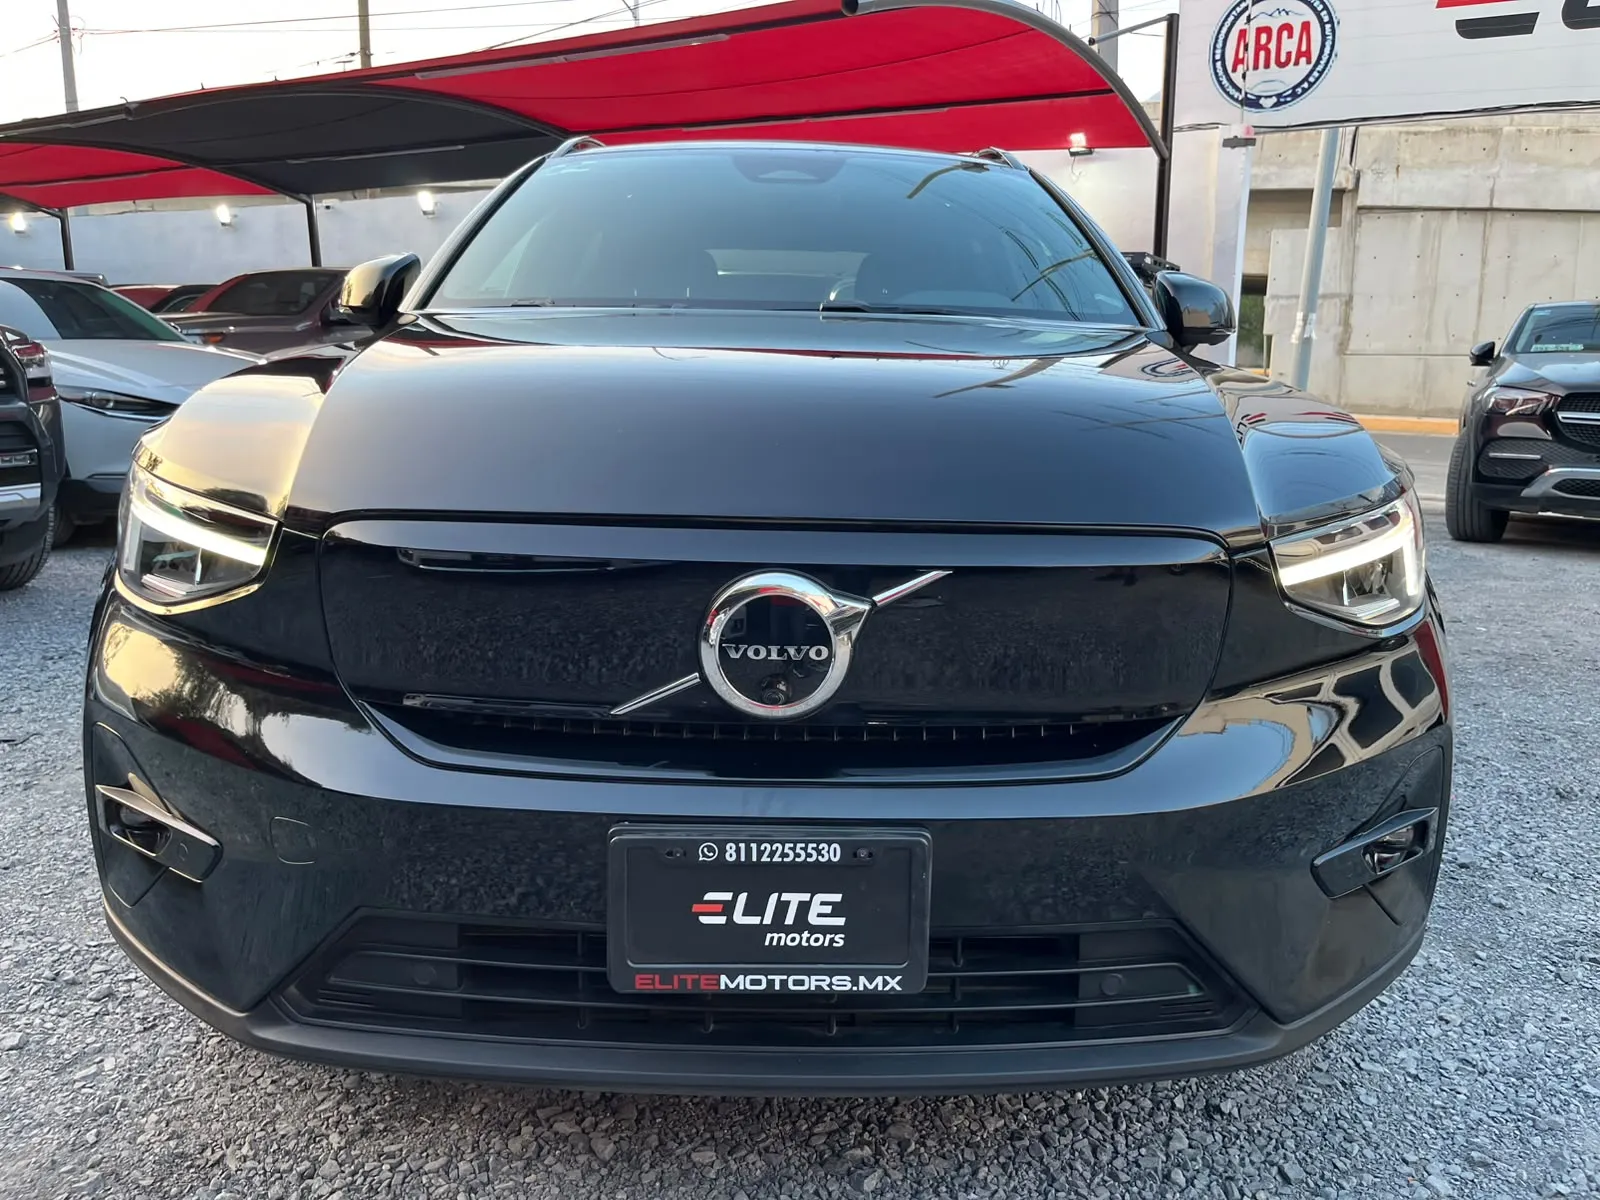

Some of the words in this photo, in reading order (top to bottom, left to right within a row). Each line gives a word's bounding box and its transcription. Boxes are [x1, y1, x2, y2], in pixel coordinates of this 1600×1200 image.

[1231, 20, 1312, 73] ARCA
[722, 643, 829, 660] VOLVO
[725, 842, 841, 862] 8112255530
[692, 892, 846, 926] ELITE
[764, 930, 845, 947] motors
[635, 974, 902, 991] ELITEMOTORS.MX
